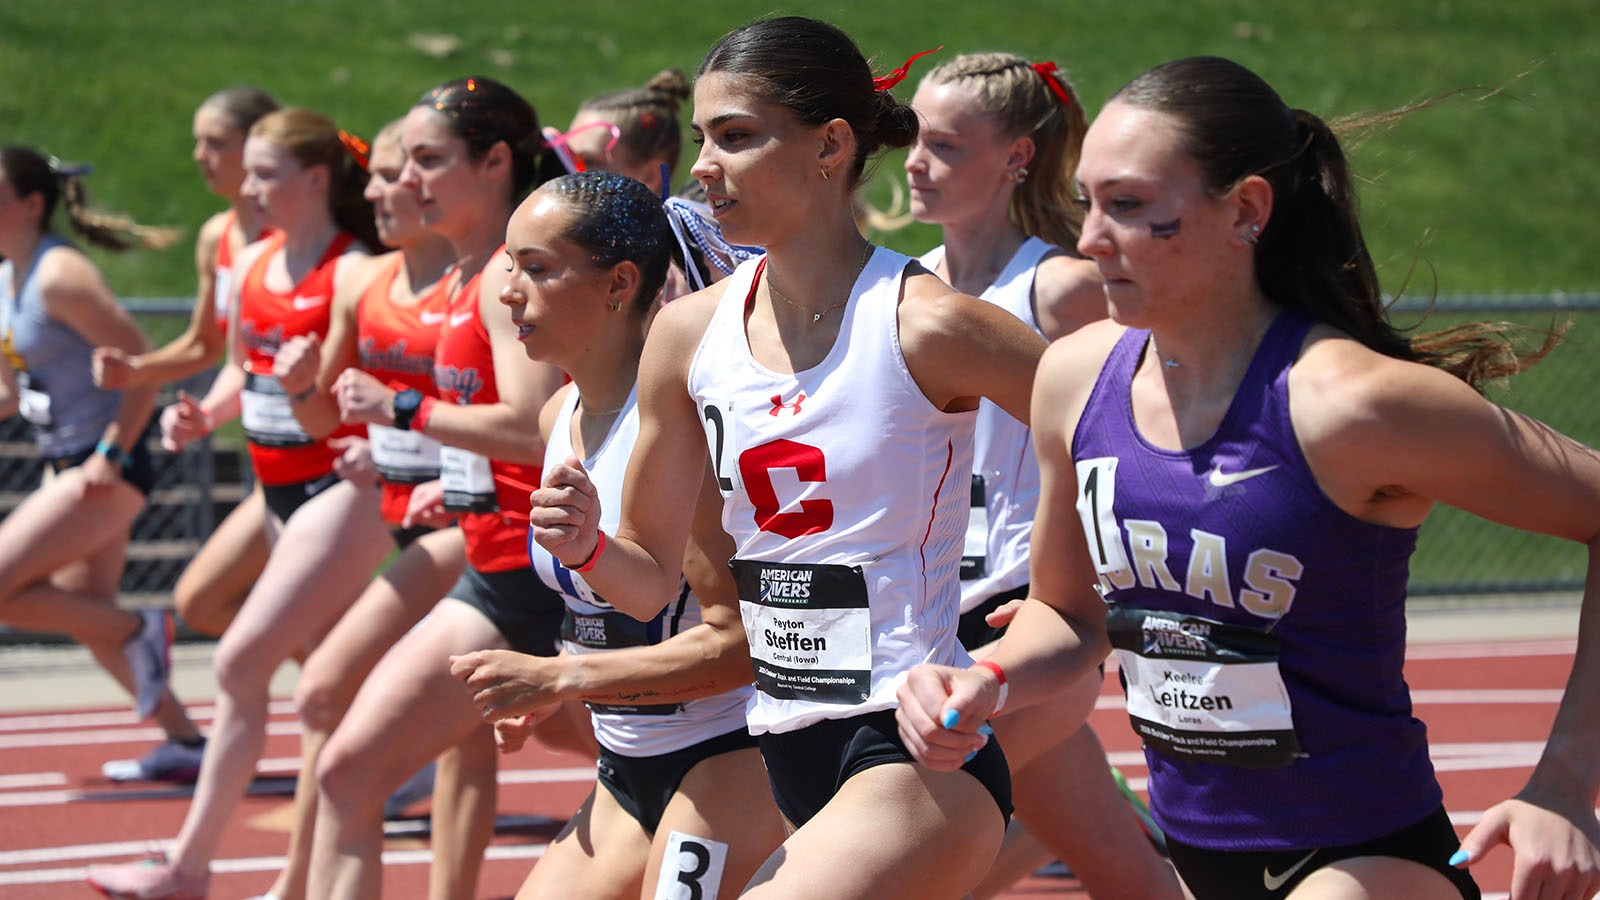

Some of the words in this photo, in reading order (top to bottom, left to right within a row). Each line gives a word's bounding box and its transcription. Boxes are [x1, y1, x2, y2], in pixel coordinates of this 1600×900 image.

[704, 405, 733, 491] 2
[738, 438, 834, 540] C
[1084, 466, 1108, 566] 1
[760, 568, 812, 582] AMERICAN
[1099, 518, 1304, 619] RAS
[773, 617, 804, 630] Peyton
[1142, 615, 1211, 636] AMERICAN
[764, 629, 826, 651] Steffen
[794, 655, 819, 666] (Iowa)
[811, 676, 855, 685] Championships
[1150, 684, 1233, 711] Leitzen
[1219, 738, 1277, 748] Championships
[677, 841, 711, 900] 3
